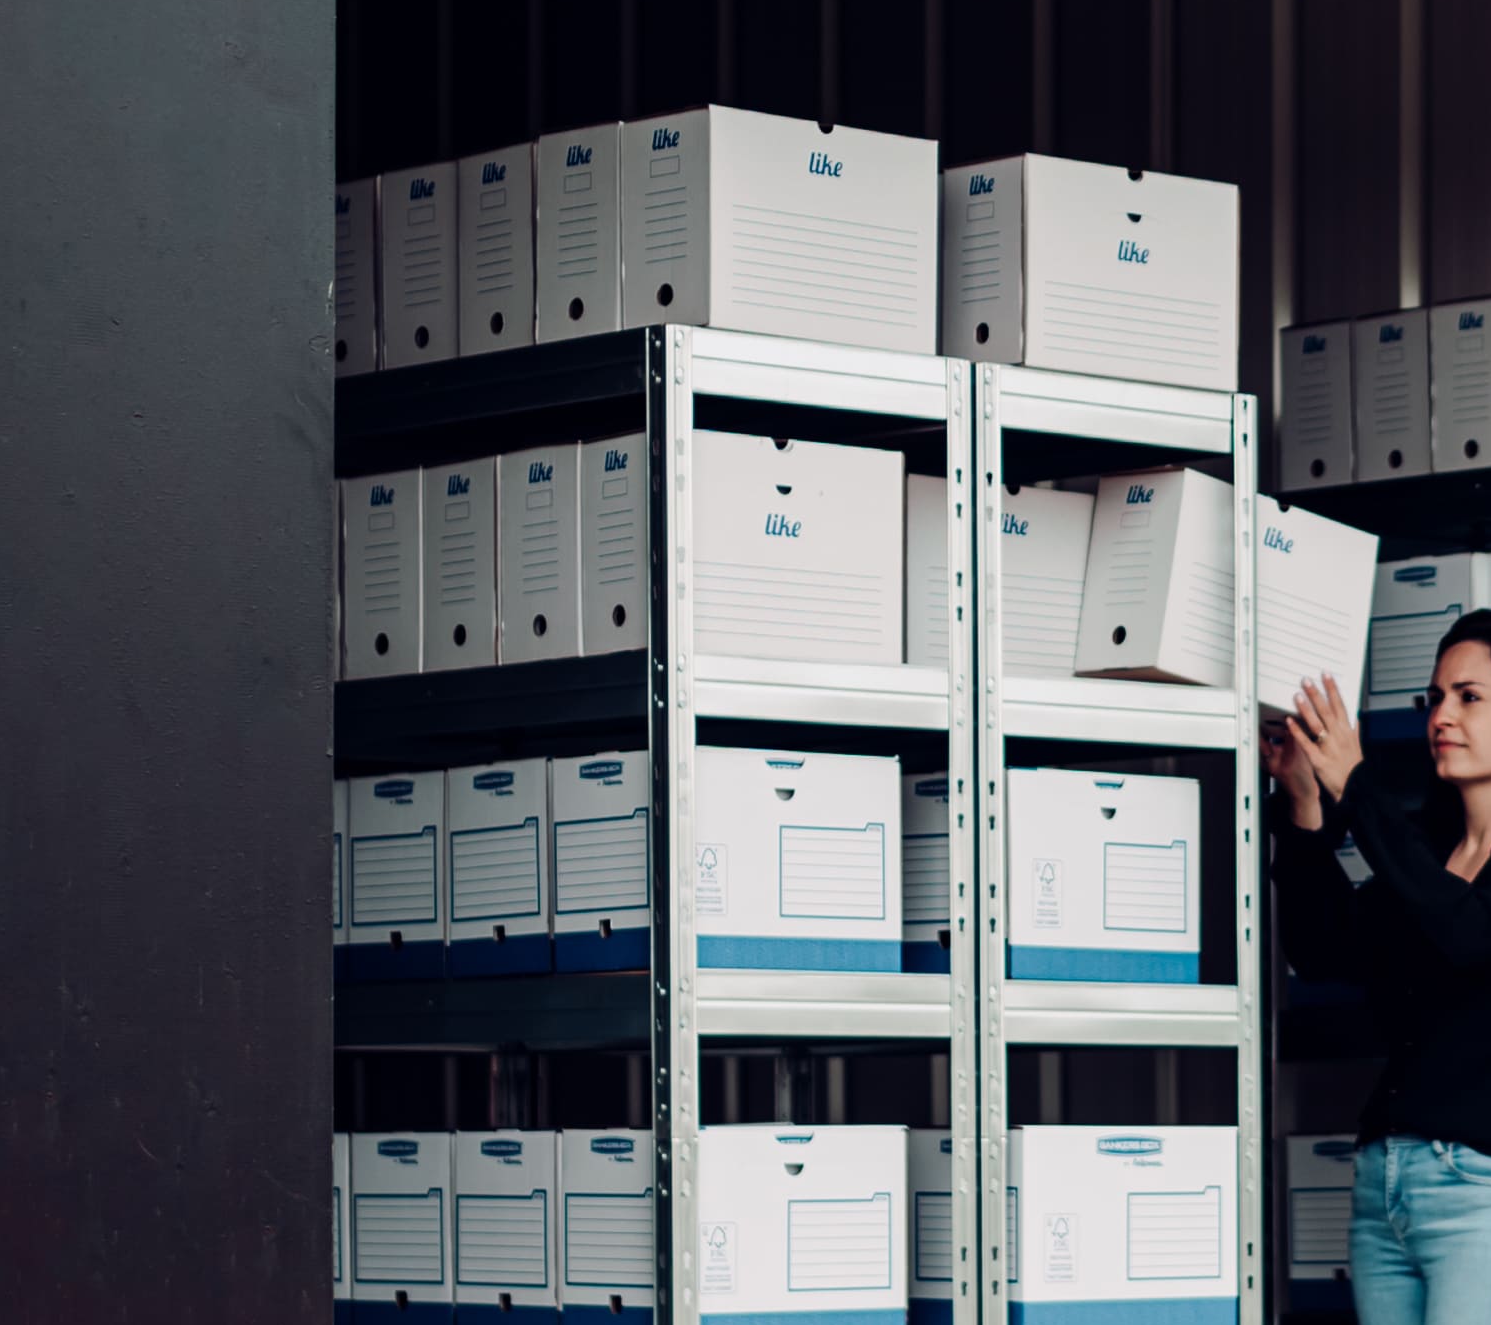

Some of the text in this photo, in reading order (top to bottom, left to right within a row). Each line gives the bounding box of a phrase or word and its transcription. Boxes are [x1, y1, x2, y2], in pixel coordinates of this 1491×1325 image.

[652, 128, 680, 150] like
[566, 145, 592, 167] like
[809, 152, 842, 177] like
[969, 175, 994, 196] like
[1118, 241, 1149, 264] like
[605, 450, 628, 472] like
[529, 462, 553, 484] like
[1126, 485, 1154, 504] like
[765, 514, 801, 537] like
[1264, 527, 1294, 554] like
